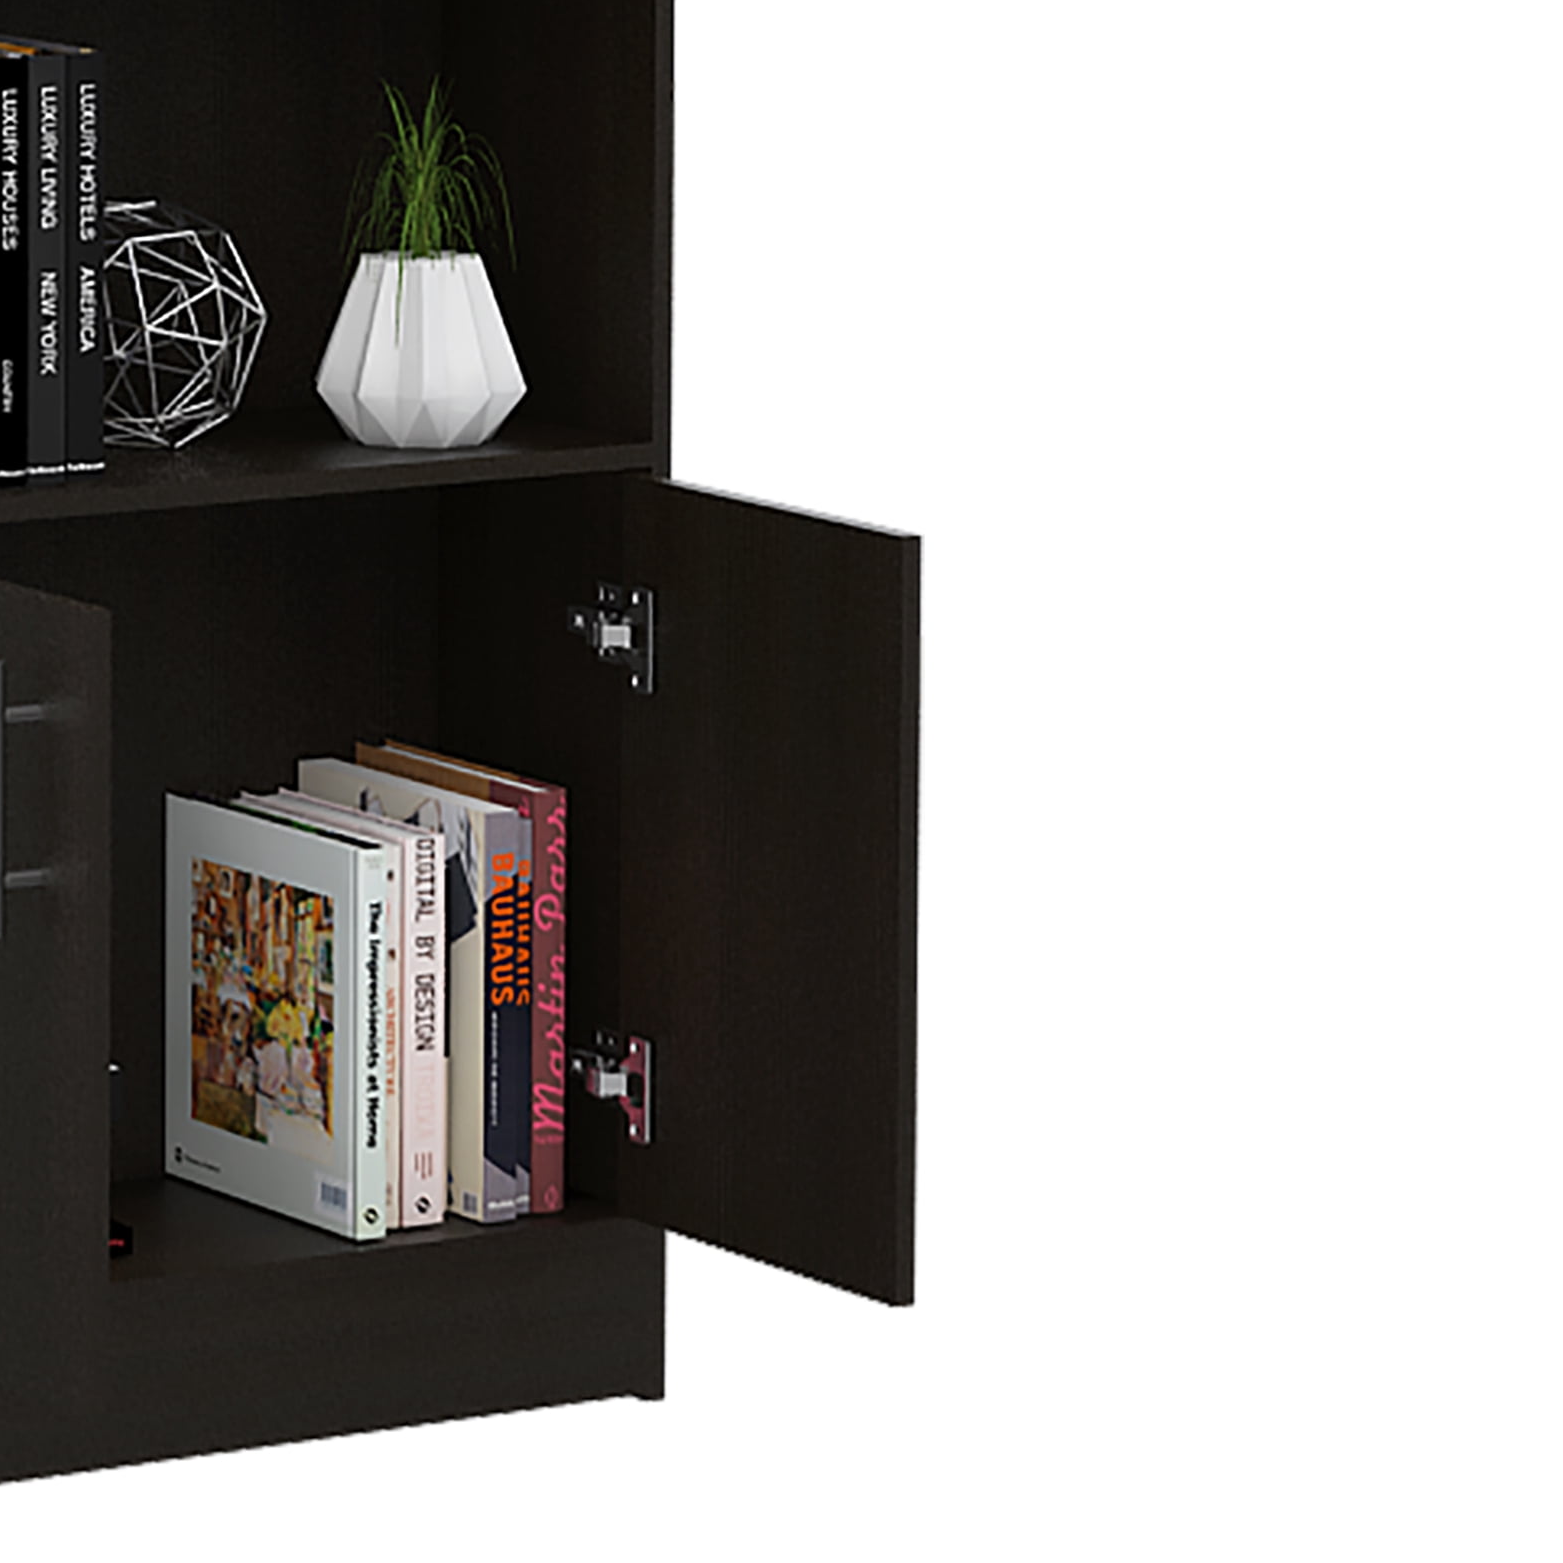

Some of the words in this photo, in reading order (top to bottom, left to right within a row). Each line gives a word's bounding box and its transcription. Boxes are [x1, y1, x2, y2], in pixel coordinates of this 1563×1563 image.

[1, 88, 19, 165] LUXURY
[40, 86, 58, 163] LUXURY
[79, 83, 97, 160] LUXURY
[1, 169, 19, 251] HOUSES
[40, 166, 58, 229] LIVING
[79, 163, 97, 241] HOTELS
[40, 271, 57, 316] NEW
[79, 266, 96, 353] AMERICA
[40, 317, 57, 375] YORK
[414, 837, 436, 923] DIGITAL
[532, 794, 567, 932] Parr
[369, 901, 383, 936] The
[414, 935, 436, 961] BY
[490, 852, 515, 1007] BAUHAUS
[365, 939, 382, 1069] Impressionists
[414, 973, 436, 1052] DESIGN
[532, 943, 566, 1132] Martin
[366, 1074, 380, 1093] at
[366, 1096, 380, 1149] Home
